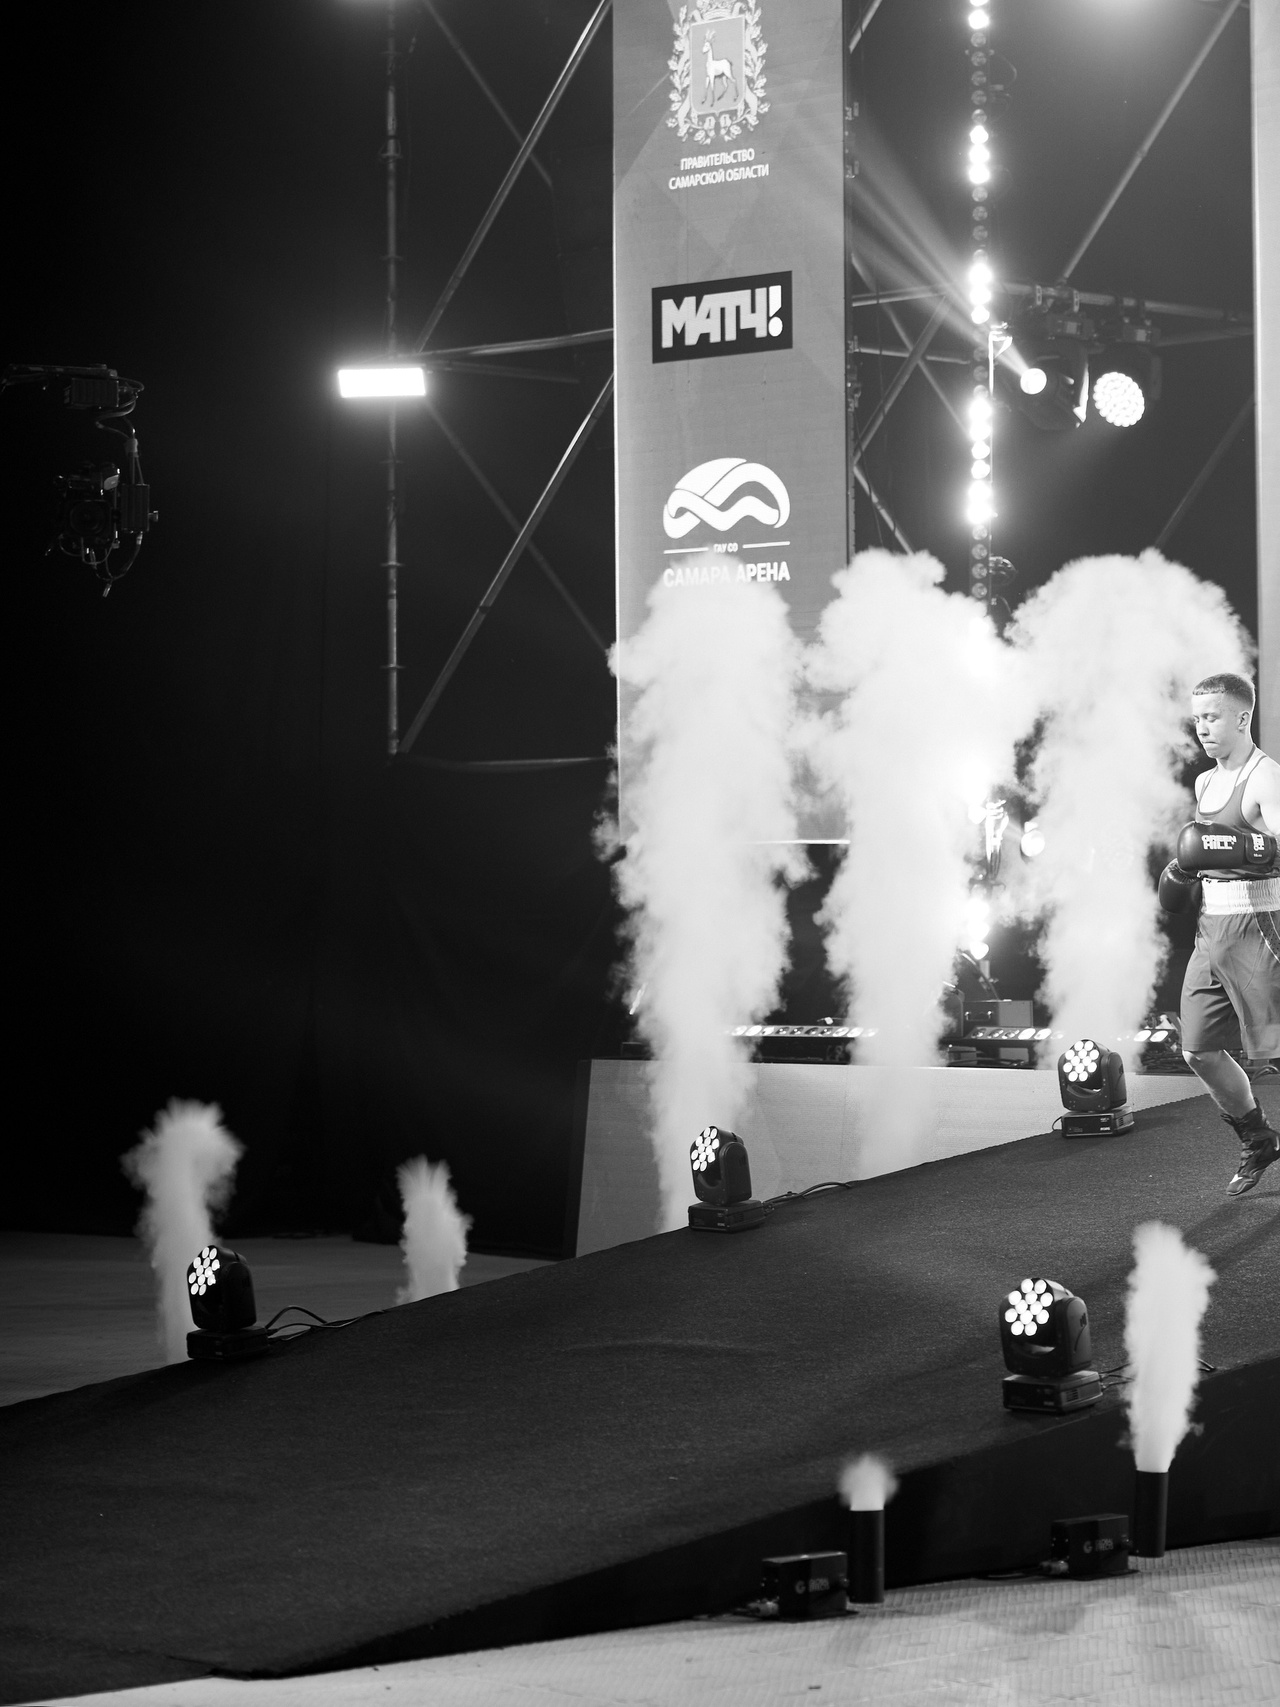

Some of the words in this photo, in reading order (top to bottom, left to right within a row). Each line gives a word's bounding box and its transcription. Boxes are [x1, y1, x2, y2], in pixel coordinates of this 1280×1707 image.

[680, 148, 755, 171] ПРАВИТЕЛЬСТВО
[668, 168, 725, 190] САМАРСКОЙ
[725, 163, 770, 182] ОБЛАСТИ
[661, 285, 783, 349] МАТЧ!
[663, 565, 731, 588] САМАРА
[737, 561, 791, 582] АРЕНА
